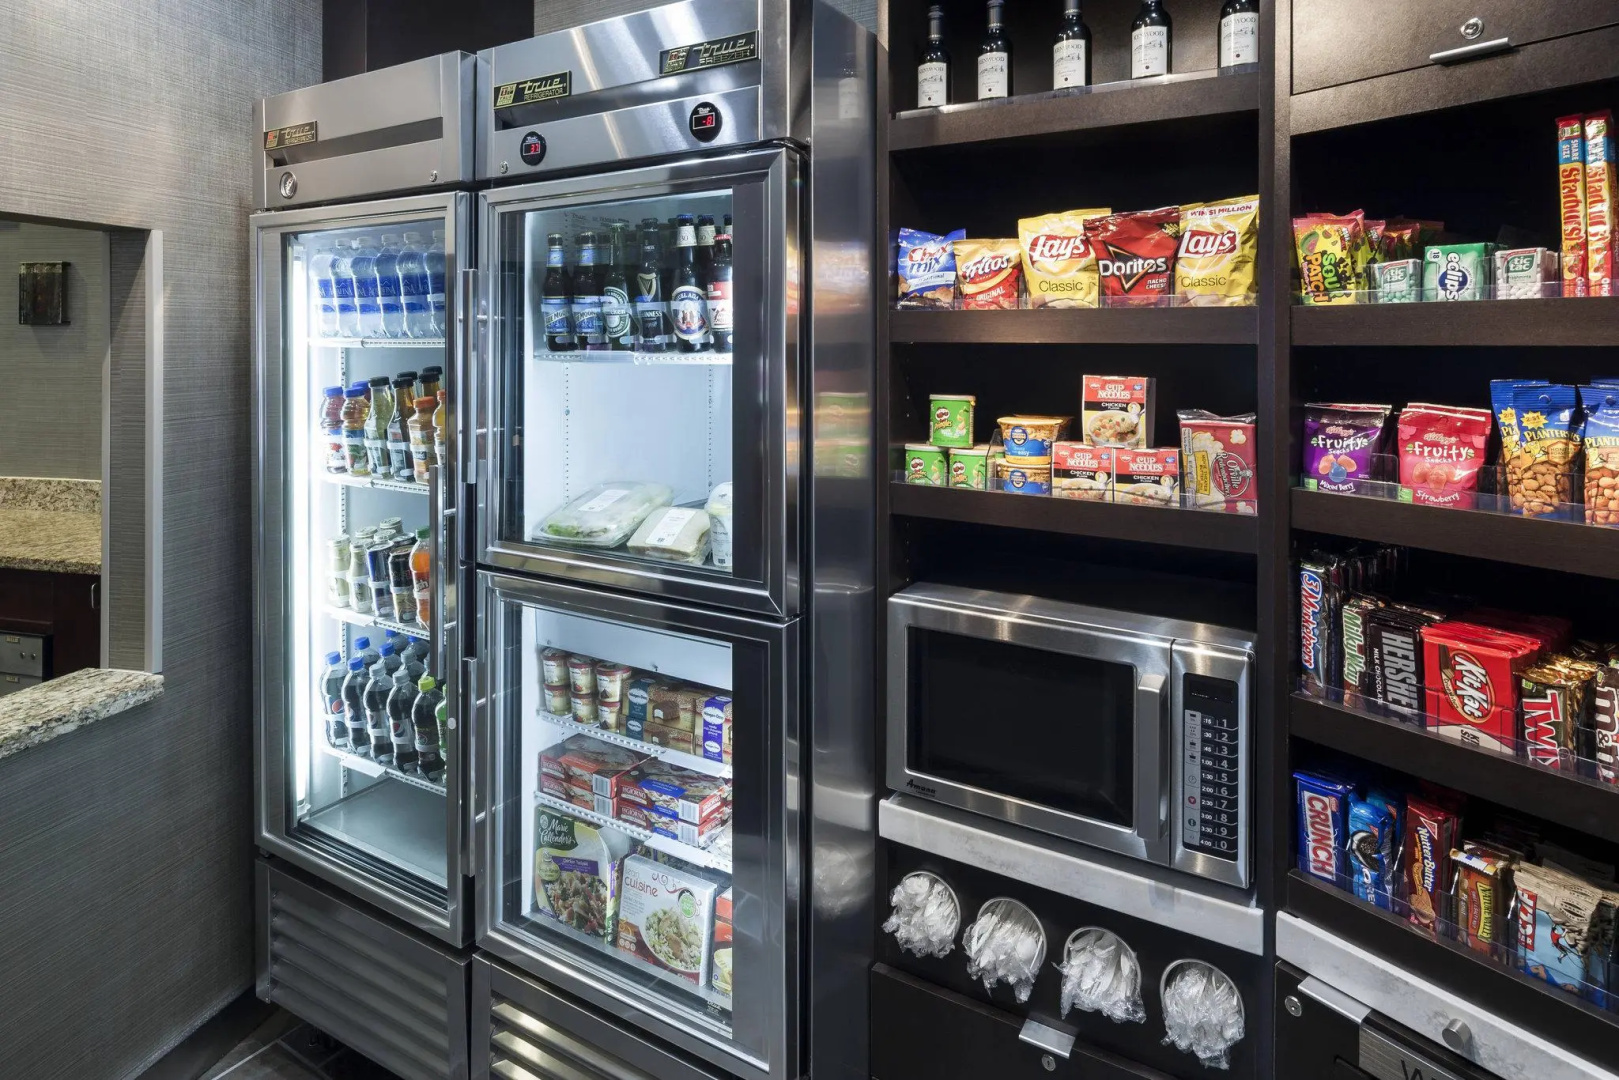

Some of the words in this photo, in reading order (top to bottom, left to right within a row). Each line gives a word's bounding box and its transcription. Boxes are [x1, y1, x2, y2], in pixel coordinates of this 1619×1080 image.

[700, 50, 750, 65] FREEZER
[524, 88, 564, 101] REFRIGERATOR
[1562, 144, 1570, 159] SIZE
[1571, 139, 1579, 161] SHARE
[1218, 205, 1252, 214] MILLION
[1561, 166, 1585, 242] Starburst
[1178, 231, 1235, 258] Lay's
[1099, 257, 1167, 276] Doritos
[1512, 257, 1531, 265] tic
[961, 253, 1010, 283] Fritos
[1181, 275, 1227, 288] Classic
[1306, 252, 1331, 302] PATCH
[1445, 252, 1462, 301] eclips
[1039, 279, 1084, 292] Classic
[1097, 390, 1131, 399] NOODLES
[1318, 434, 1363, 452] fruity
[1585, 436, 1619, 448] PLANT
[1414, 442, 1469, 462] fruity
[1066, 458, 1098, 468] NOODLES
[1129, 462, 1164, 472] NOODLES
[1226, 459, 1241, 489] Orville
[1416, 489, 1460, 502] Strawberry
[1382, 631, 1419, 712] HERSHE
[1222, 719, 1227, 728] 1
[1221, 733, 1228, 741] 2
[1221, 746, 1228, 755] 3
[1221, 760, 1228, 769] 4
[1221, 773, 1227, 781] 5
[907, 779, 936, 794] Amana
[1221, 787, 1228, 796] 6
[1221, 800, 1227, 808] 7
[1221, 814, 1227, 822] 8
[548, 818, 569, 835] Marie
[1221, 827, 1227, 836] 9
[1307, 796, 1334, 877] CRUNCH
[1221, 841, 1227, 849] 0
